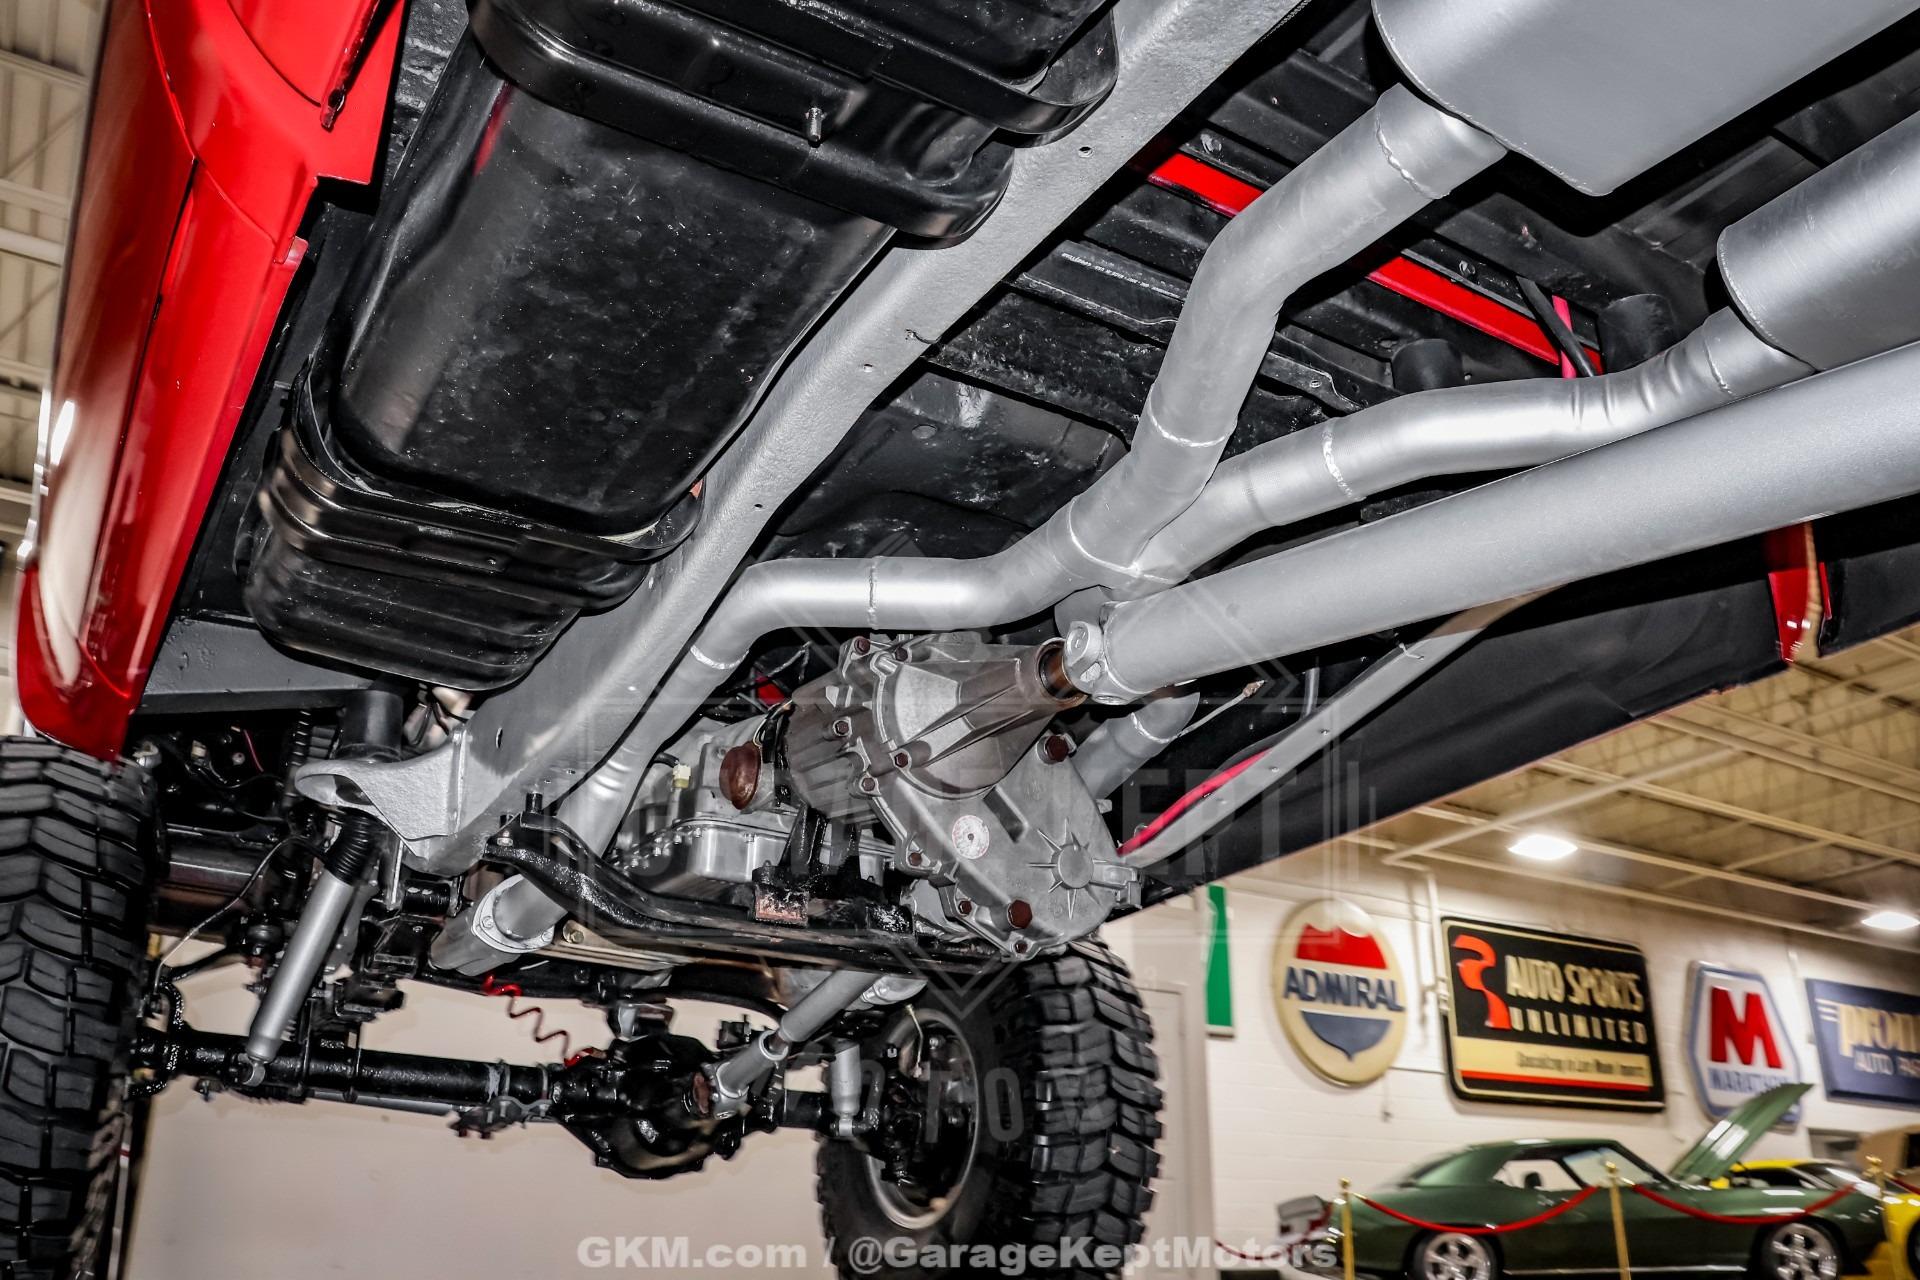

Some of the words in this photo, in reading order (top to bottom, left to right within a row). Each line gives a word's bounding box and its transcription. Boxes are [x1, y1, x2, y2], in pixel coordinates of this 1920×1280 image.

[1283, 966, 1405, 1012] ADMIRAL
[1505, 954, 1565, 1003] AUTO
[1508, 1006, 1647, 1044] UNLIMITED
[1710, 986, 1783, 1069] M
